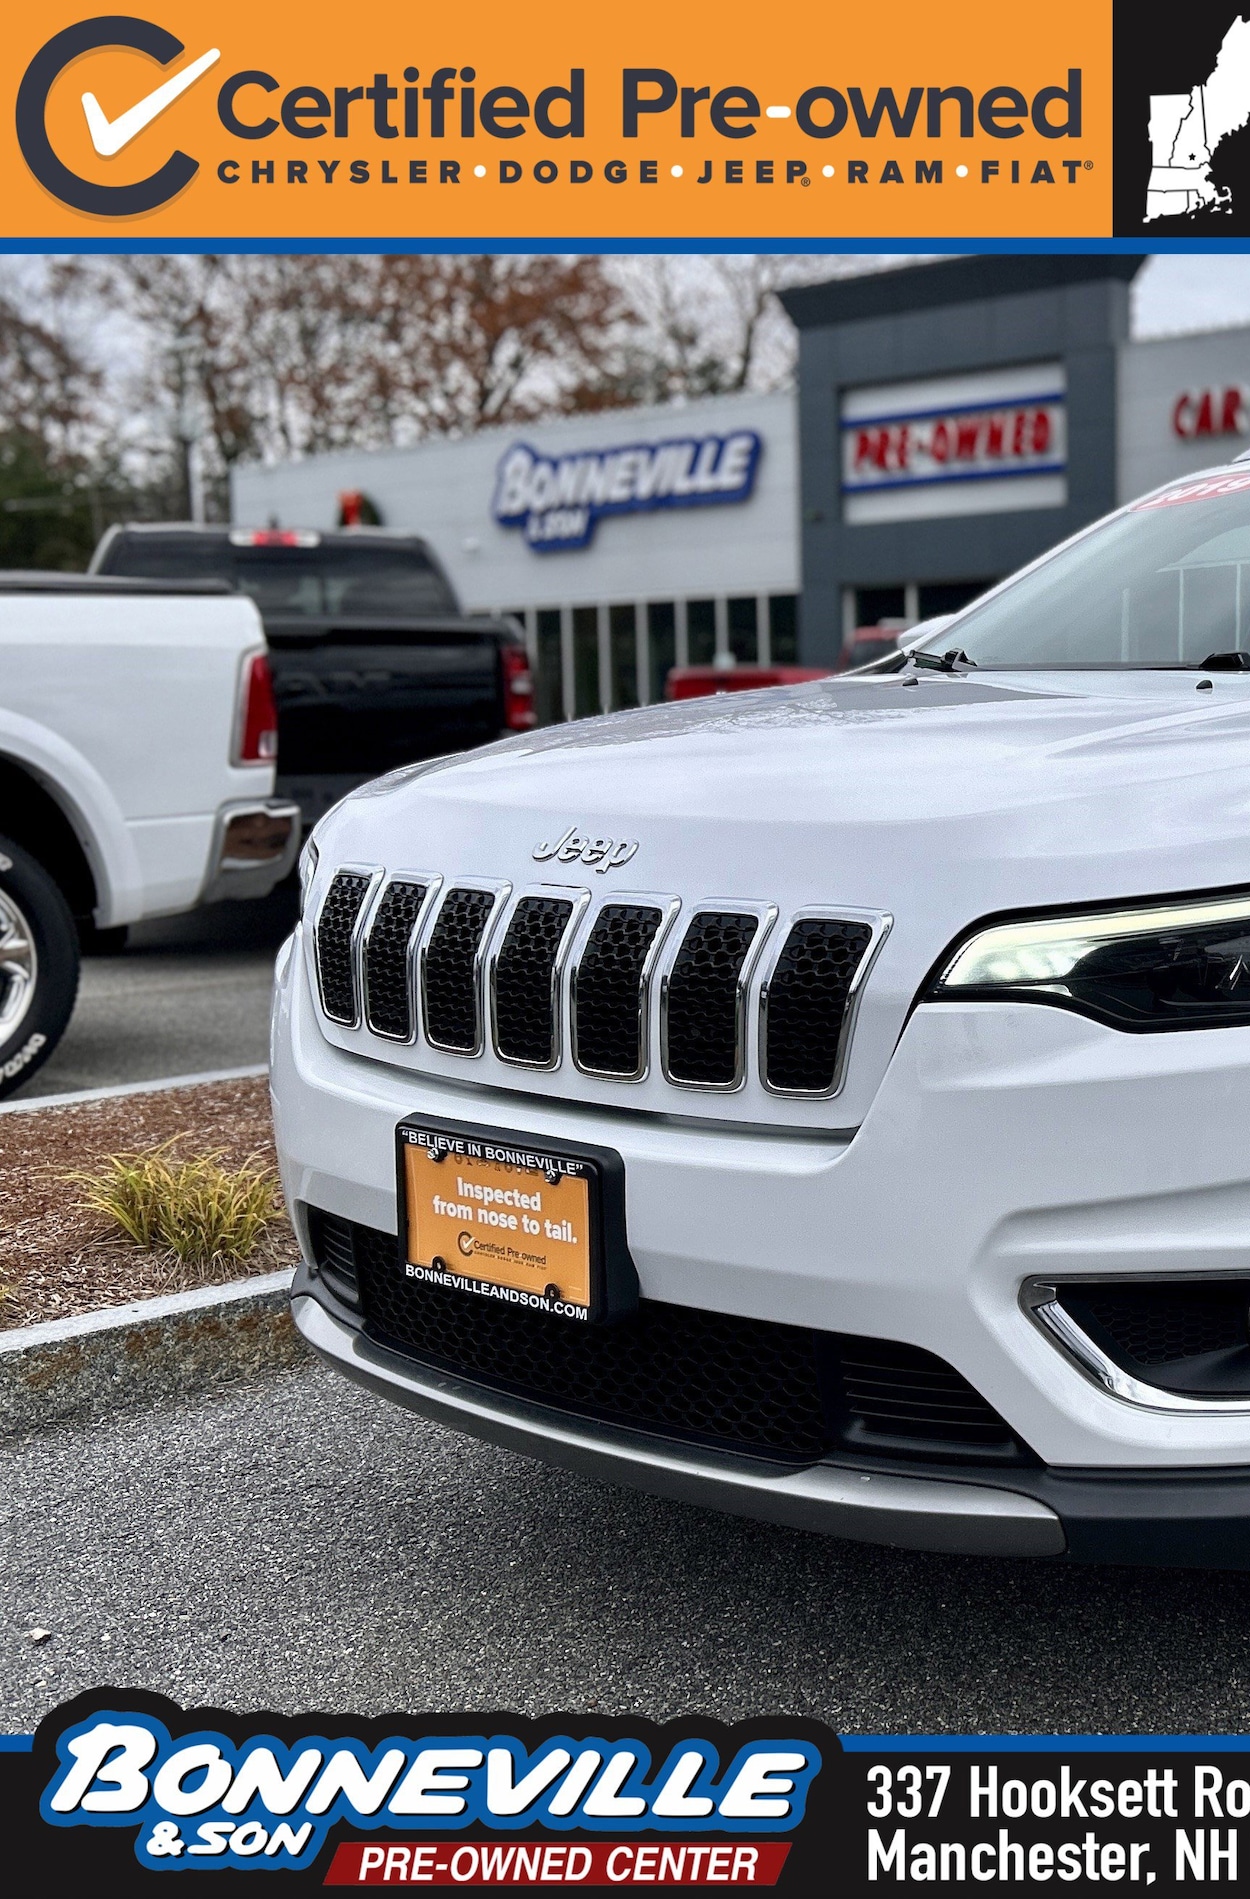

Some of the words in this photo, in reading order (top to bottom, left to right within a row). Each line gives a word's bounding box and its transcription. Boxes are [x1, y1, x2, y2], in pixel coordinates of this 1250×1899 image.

[1173, 386, 1247, 438] CAR
[853, 406, 1051, 474] PRE-OWNED
[500, 433, 754, 517] BONNEVILLE
[532, 825, 640, 875] Jeep
[467, 1143, 482, 1158] IN
[432, 1194, 473, 1221] from
[477, 1207, 518, 1231] nose
[521, 1216, 540, 1236] to
[543, 1219, 578, 1245] tail.
[456, 1176, 542, 1212] Inspected
[473, 1240, 505, 1255] Certified
[405, 1263, 589, 1321] BONNEVILLEANDSON.COM
